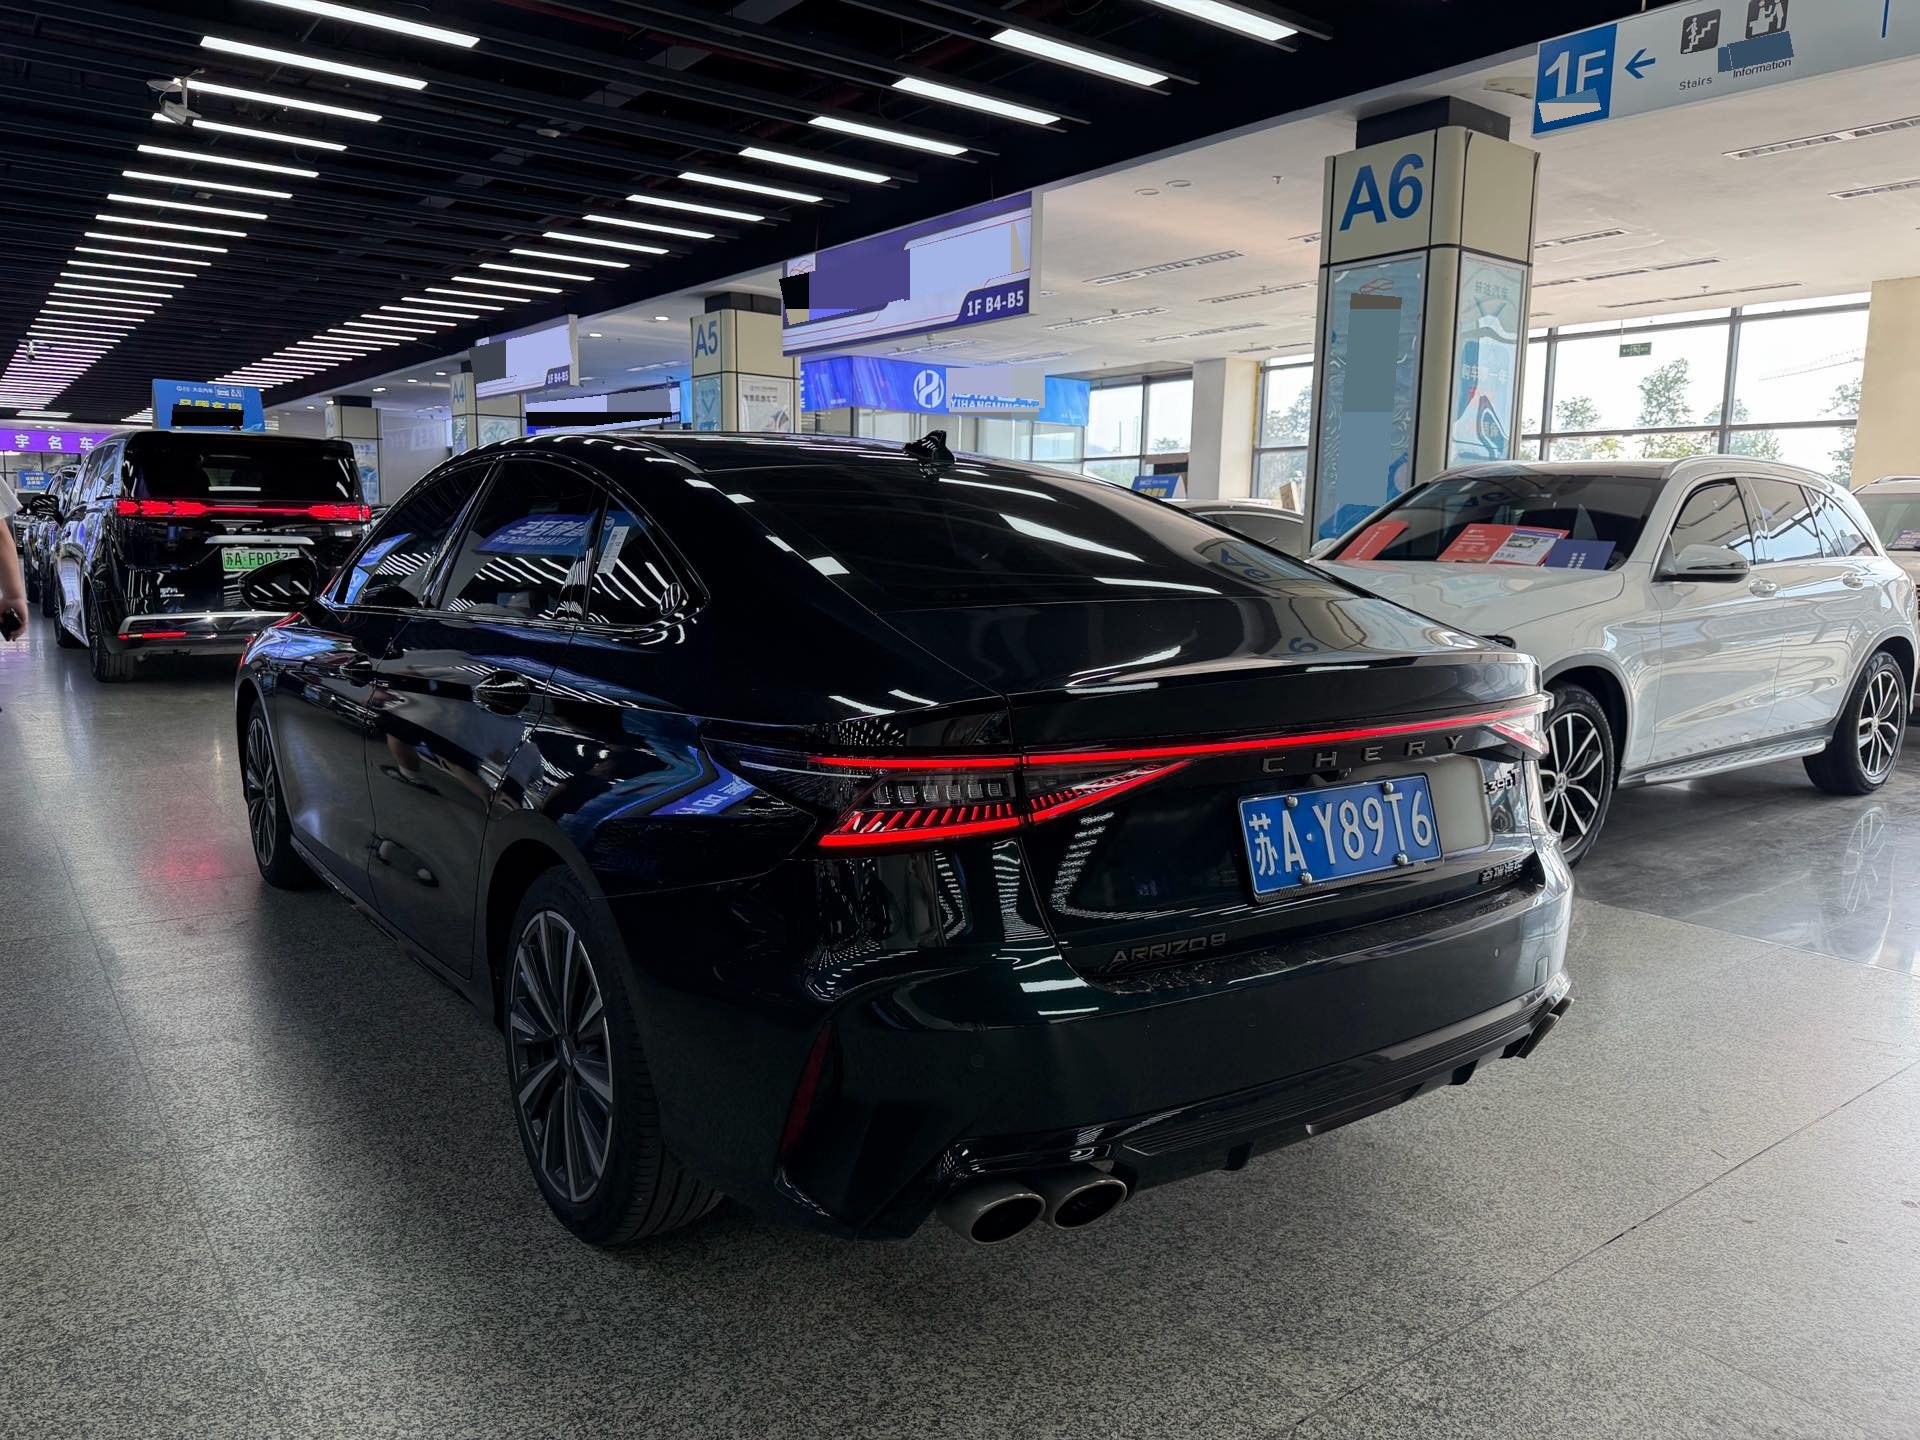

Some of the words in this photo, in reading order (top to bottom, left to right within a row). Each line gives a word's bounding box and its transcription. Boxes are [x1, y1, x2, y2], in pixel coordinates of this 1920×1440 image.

[1544, 49, 1607, 98] 1F
[1678, 75, 1713, 91] Stairs
[1732, 58, 1792, 79] Information
[1339, 153, 1425, 232] A6
[966, 298, 983, 317] 1F
[985, 289, 1025, 314] B4-B5
[694, 320, 719, 359] A5
[453, 380, 465, 403] A4
[1260, 735, 1464, 774] CHERY
[1248, 790, 1433, 877] 苏A·Y89T6
